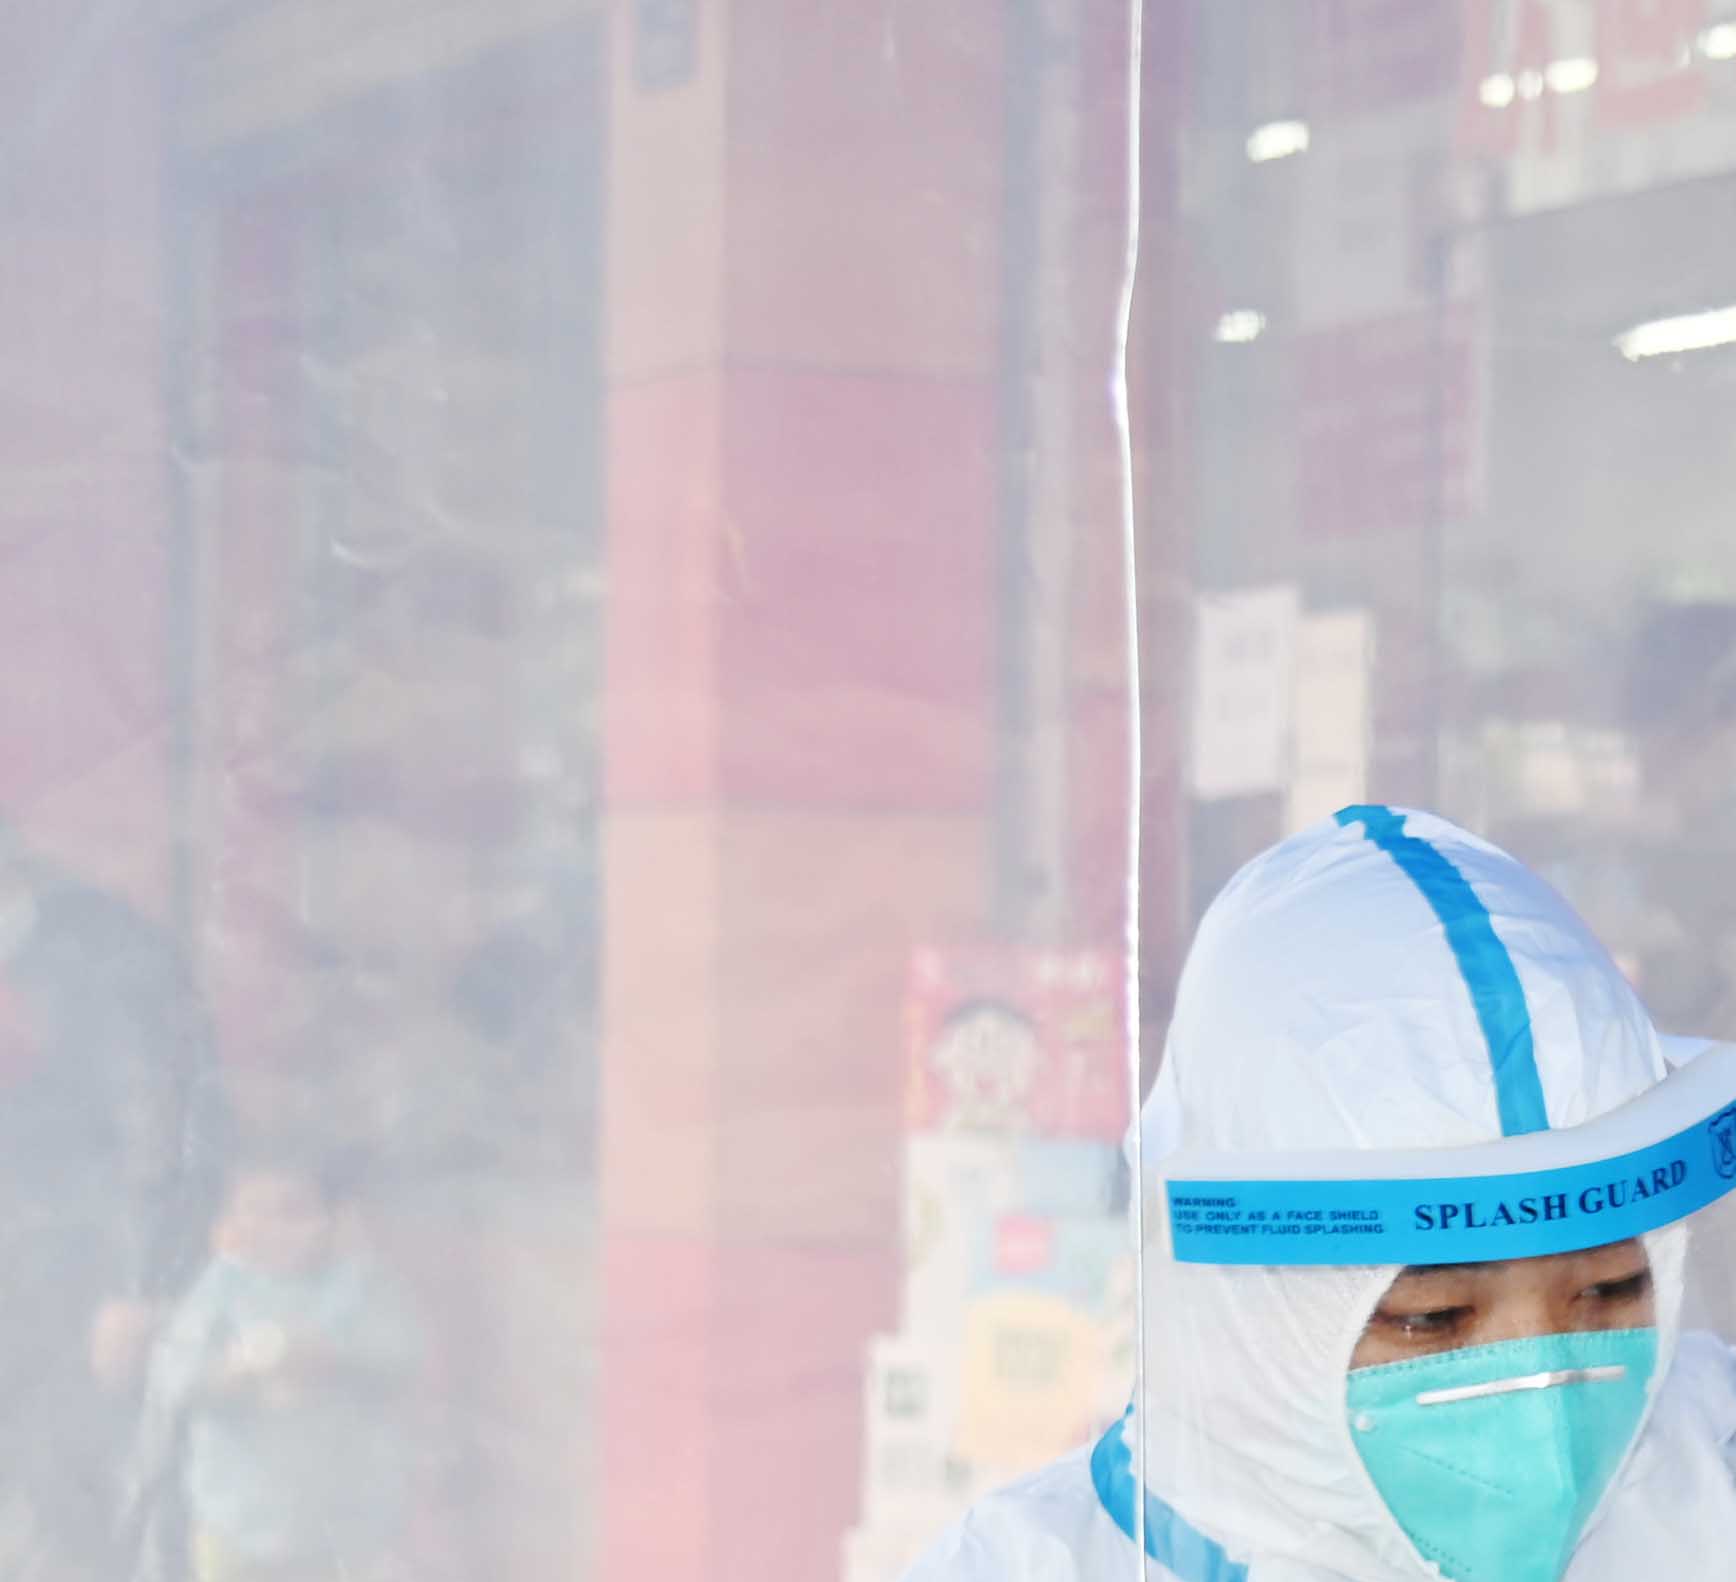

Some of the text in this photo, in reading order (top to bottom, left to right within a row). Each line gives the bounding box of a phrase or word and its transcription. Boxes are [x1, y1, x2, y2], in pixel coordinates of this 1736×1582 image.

[1414, 1159, 1688, 1231] SPLASH GUARD
[1175, 1210, 1380, 1221] USE ONLY AS A FACE SHIELD
[1175, 1223, 1385, 1234] TO PREVENT FLUID SPLASHING
